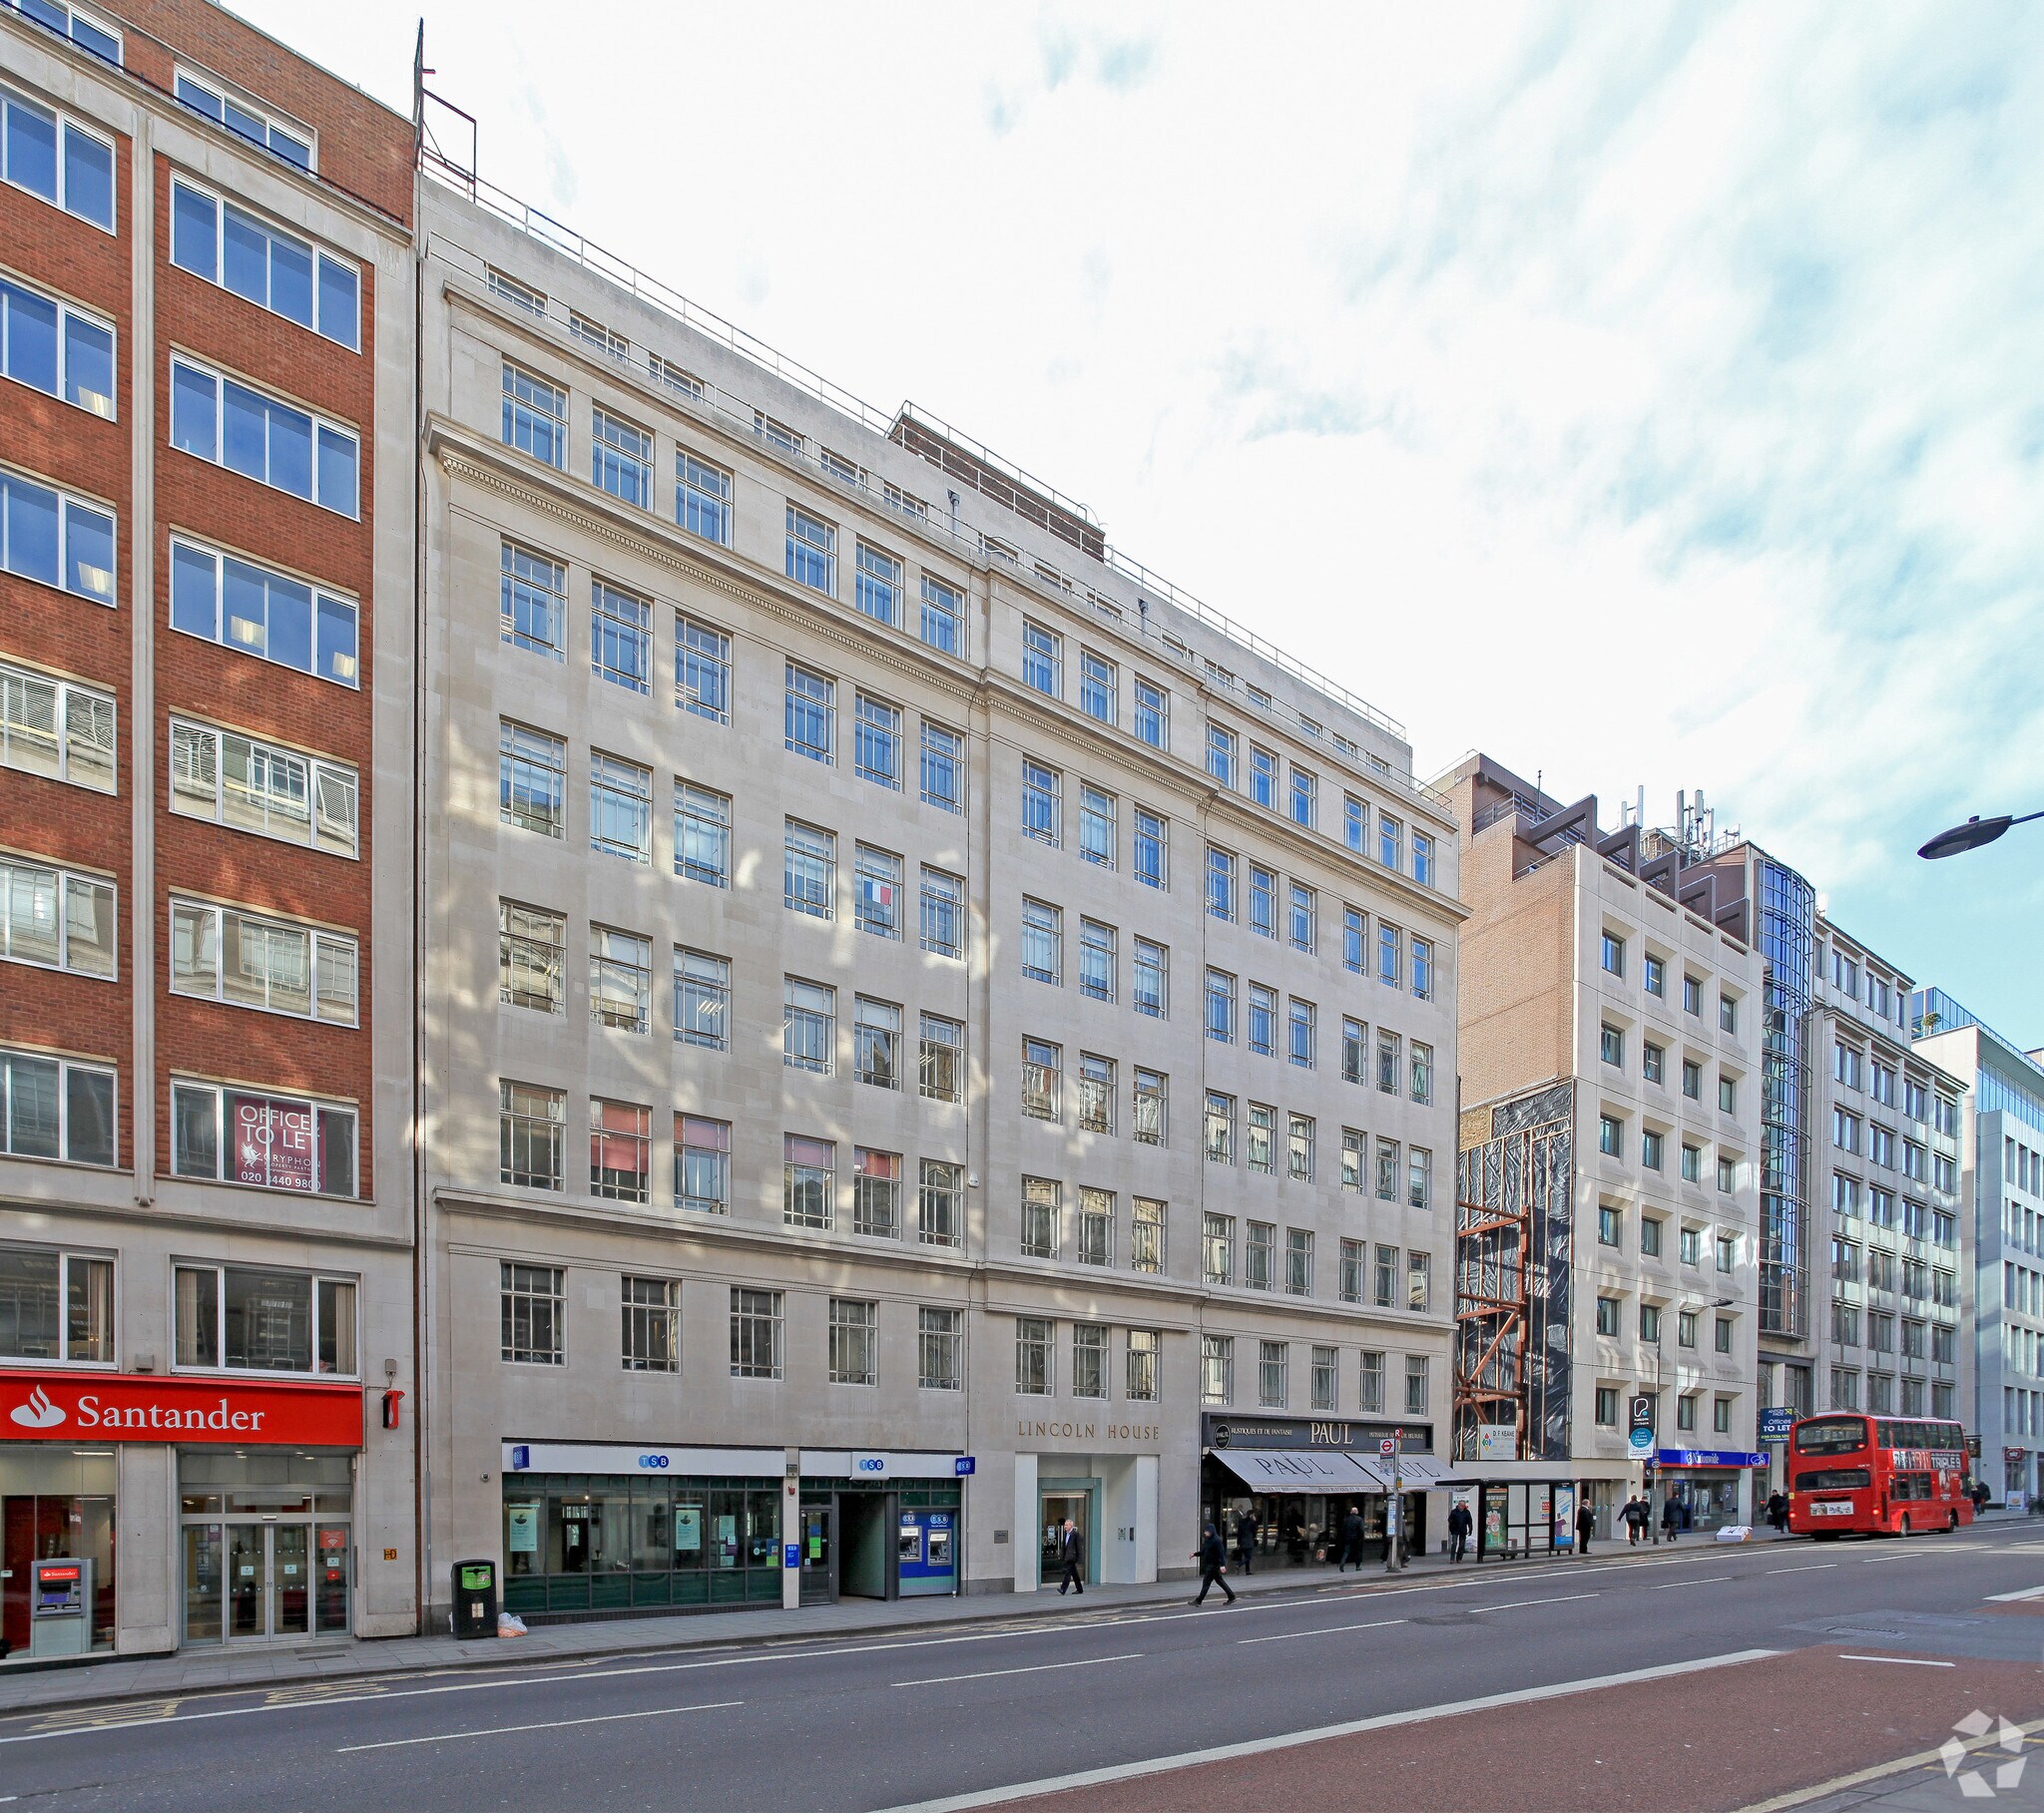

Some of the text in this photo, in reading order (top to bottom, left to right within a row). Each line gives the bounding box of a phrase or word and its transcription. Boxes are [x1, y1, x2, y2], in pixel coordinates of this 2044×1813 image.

[241, 1106, 319, 1132] OFFICE
[241, 1123, 275, 1144] TO
[263, 1153, 320, 1167] RYPHO
[241, 1170, 261, 1182] 020
[265, 1174, 291, 1185] 440
[77, 1395, 265, 1431] Santander
[1018, 1421, 1159, 1440] LINCOLN HOUSE
[1231, 1427, 1257, 1436] RUSTIQUES
[1309, 1422, 1354, 1445] PAUL
[641, 1456, 668, 1467] TSB
[860, 1460, 882, 1470] TSB
[1254, 1457, 1334, 1477] PAUL
[1930, 1457, 1961, 1469] TRIPLE 9
